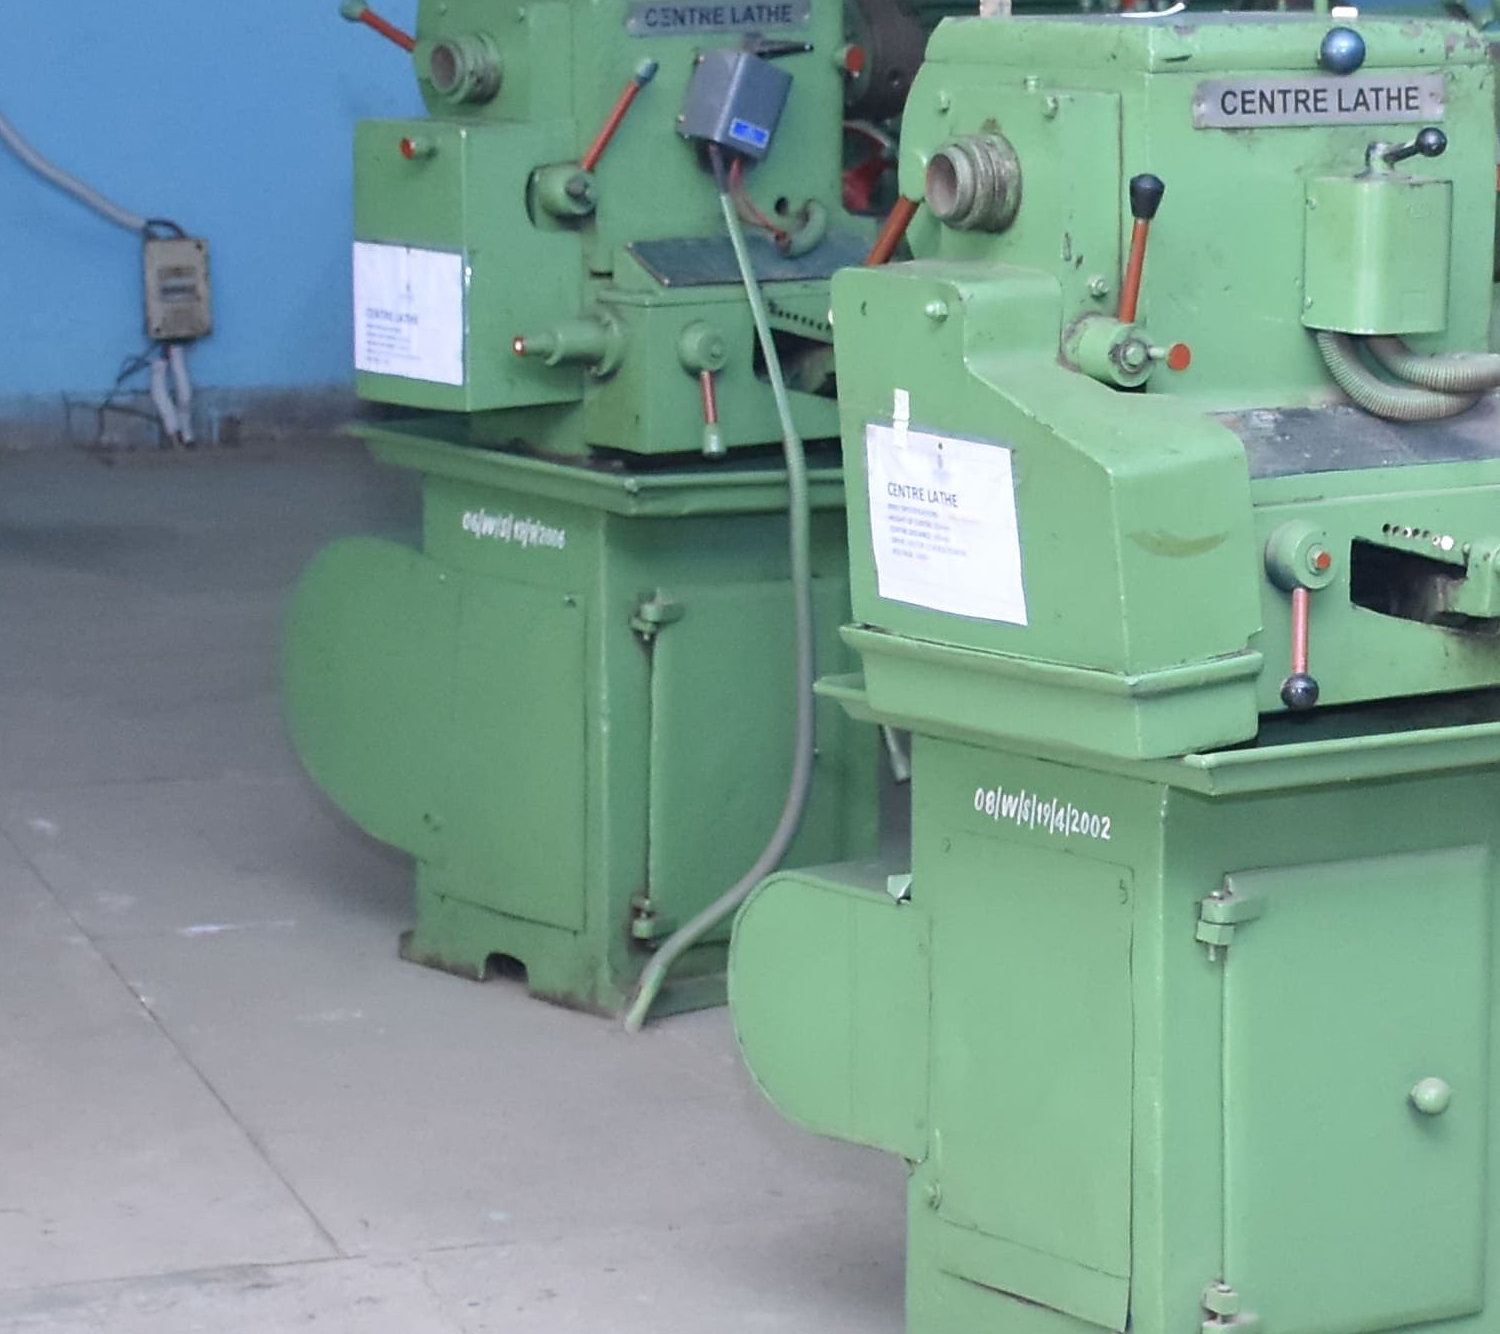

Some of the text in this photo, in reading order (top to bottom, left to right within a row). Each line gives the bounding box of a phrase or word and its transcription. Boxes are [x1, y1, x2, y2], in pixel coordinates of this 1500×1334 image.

[645, 4, 793, 28] CENTRE LATHE
[1220, 86, 1420, 116] CENTRE LATHE
[887, 482, 959, 508] CENTRE LATHE
